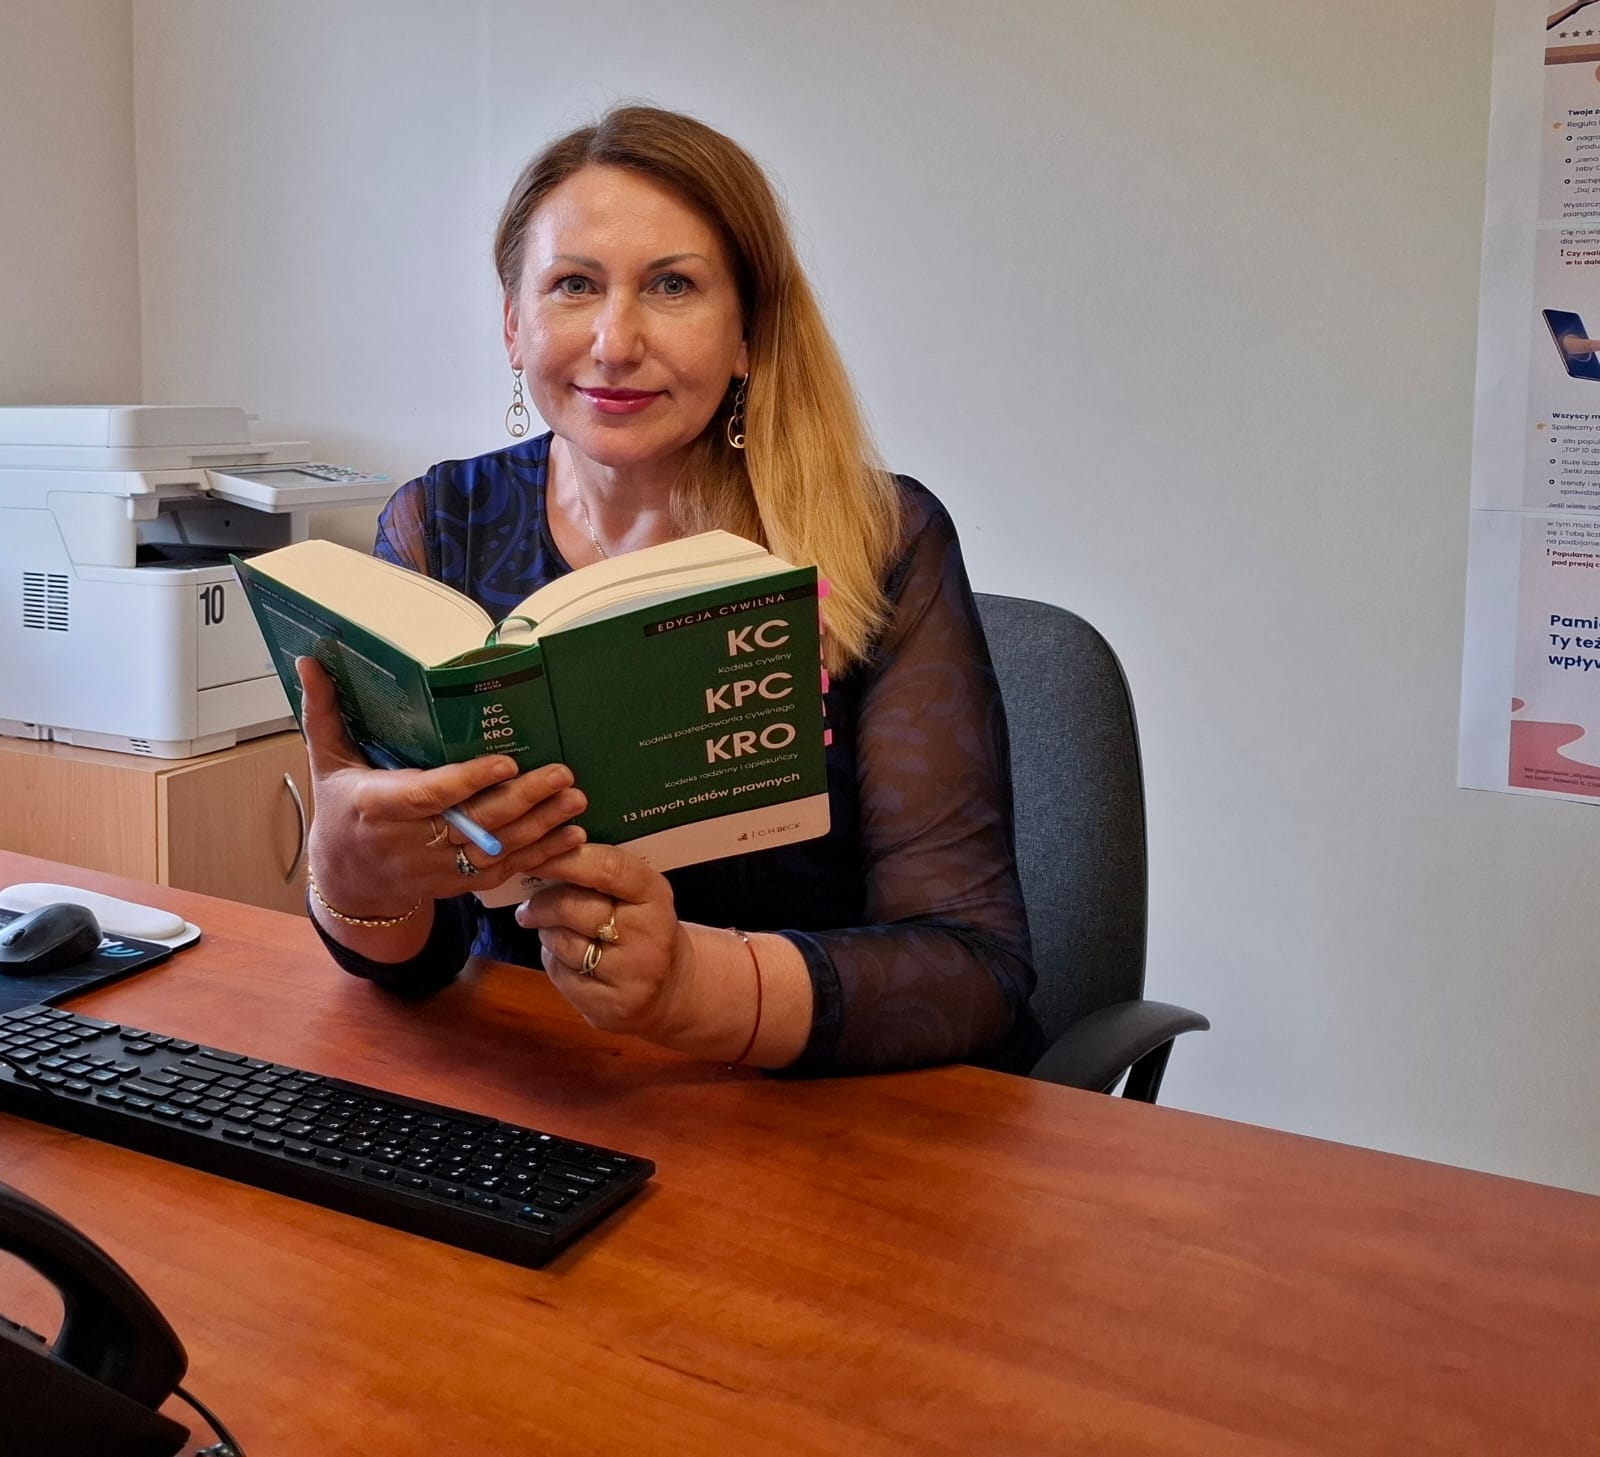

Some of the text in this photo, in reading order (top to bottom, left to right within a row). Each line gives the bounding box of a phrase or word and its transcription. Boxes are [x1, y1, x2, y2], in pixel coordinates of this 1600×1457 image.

[1552, 550, 1593, 558] Popularne
[200, 584, 224, 626] 10
[658, 593, 785, 632] EDYCJA CYWILNA
[1550, 614, 1600, 629] Pami
[727, 619, 790, 657] KC
[1549, 633, 1571, 650] Ty
[718, 652, 792, 674] Kodeks cywilny
[482, 703, 504, 715] KC
[705, 672, 793, 714] KPC
[481, 715, 511, 728] KPC
[483, 727, 514, 740] KRO
[639, 732, 673, 747] Kodeks
[745, 703, 796, 720] cywilnego
[706, 722, 796, 764] KRO
[664, 775, 698, 788] Kodeks
[699, 765, 738, 779] rodzinny
[744, 752, 799, 770] opiekuńczy
[622, 772, 800, 823] 13 innych aktów prawnych
